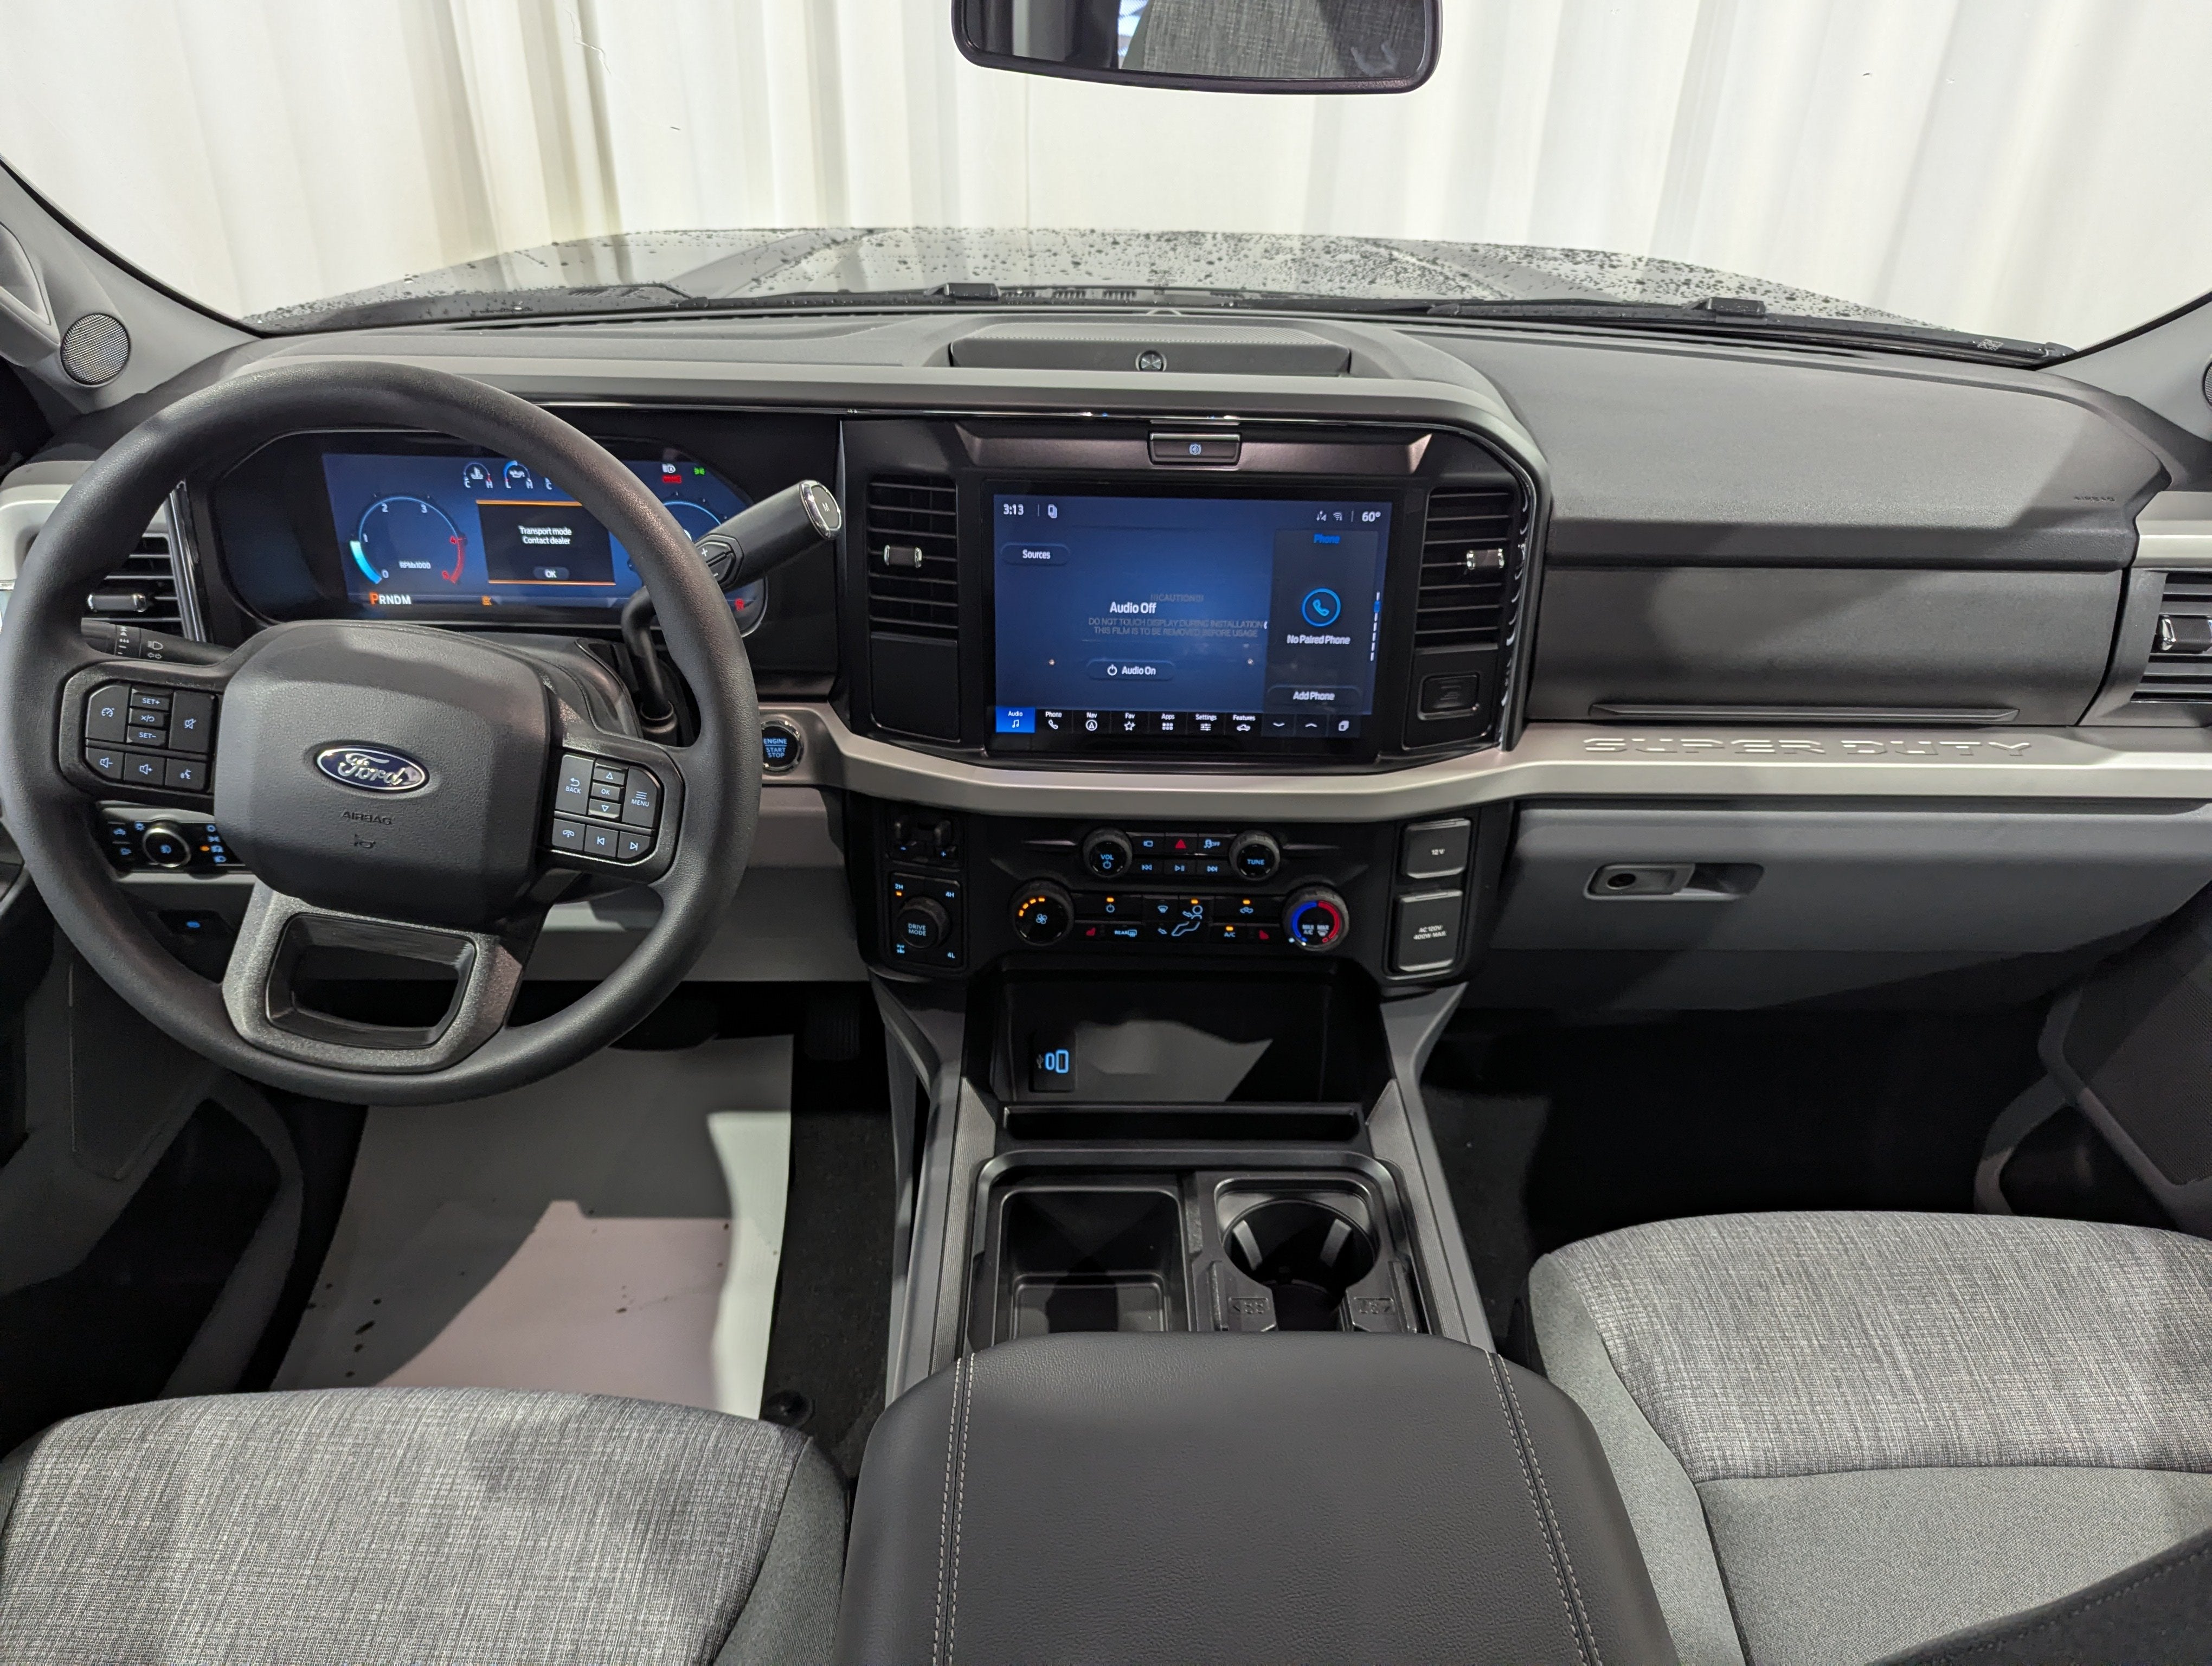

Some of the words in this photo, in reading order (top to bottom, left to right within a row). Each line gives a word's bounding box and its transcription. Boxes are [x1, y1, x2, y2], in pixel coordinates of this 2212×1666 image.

[382, 503, 388, 512] 2
[421, 504, 427, 513] 3
[822, 503, 830, 512] M
[1003, 503, 1024, 515] 3:13
[518, 526, 552, 536] Transport
[552, 527, 572, 535] mode
[363, 533, 368, 543] 1
[522, 536, 549, 544] Contact
[550, 536, 570, 544] dealer
[1314, 533, 1340, 544] Phone
[1022, 549, 1051, 559] Sources
[382, 569, 389, 579] 0
[545, 569, 557, 578] OK
[1109, 601, 1139, 613] Audio
[1141, 602, 1157, 613] Off
[1147, 619, 1178, 627] DISPLAY
[1211, 620, 1263, 629] INSTALLATION
[1095, 626, 1111, 635] THIS
[1113, 627, 1130, 635] FILM
[1140, 627, 1150, 636] TO
[1233, 630, 1258, 638] USAGE
[1287, 635, 1299, 644] No
[1300, 635, 1324, 644] Paired
[1325, 636, 1351, 644] Phone
[1122, 665, 1143, 675] Audio
[1144, 667, 1156, 675] On
[1293, 691, 1309, 700] Add
[1310, 691, 1335, 700] Phone
[1583, 739, 1825, 754] SUPER
[1841, 740, 2031, 757] DUTY
[338, 753, 402, 785] Ford
[565, 786, 581, 794] BACK
[631, 798, 650, 807] MENU
[340, 811, 392, 825] AIRBAG
[908, 922, 926, 931] DRIVE
[908, 928, 927, 937] MODE
